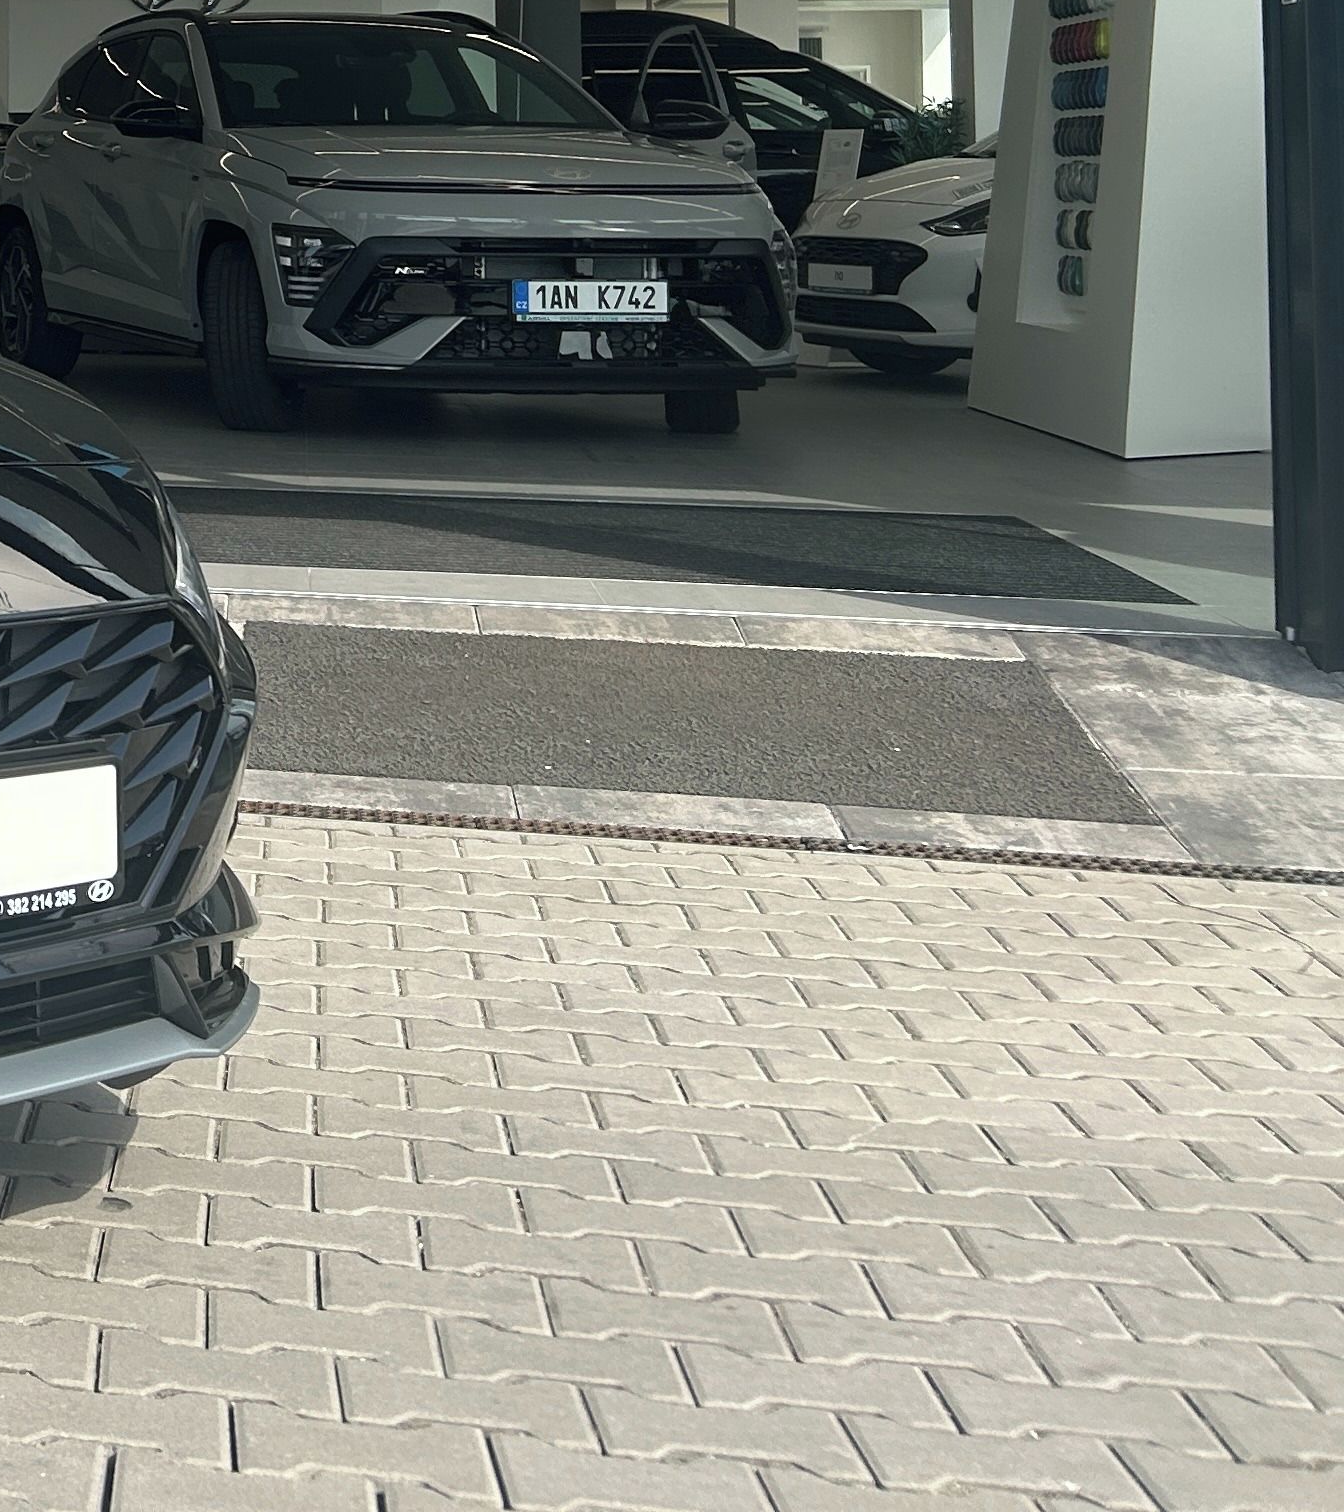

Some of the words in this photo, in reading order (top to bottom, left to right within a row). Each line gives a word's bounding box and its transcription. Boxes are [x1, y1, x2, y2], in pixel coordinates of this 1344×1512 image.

[515, 300, 528, 309] CZ
[536, 284, 579, 310] 1AN
[597, 284, 657, 310] K742
[6, 898, 29, 916] 382
[30, 893, 53, 911] 214
[55, 888, 77, 908] 295
